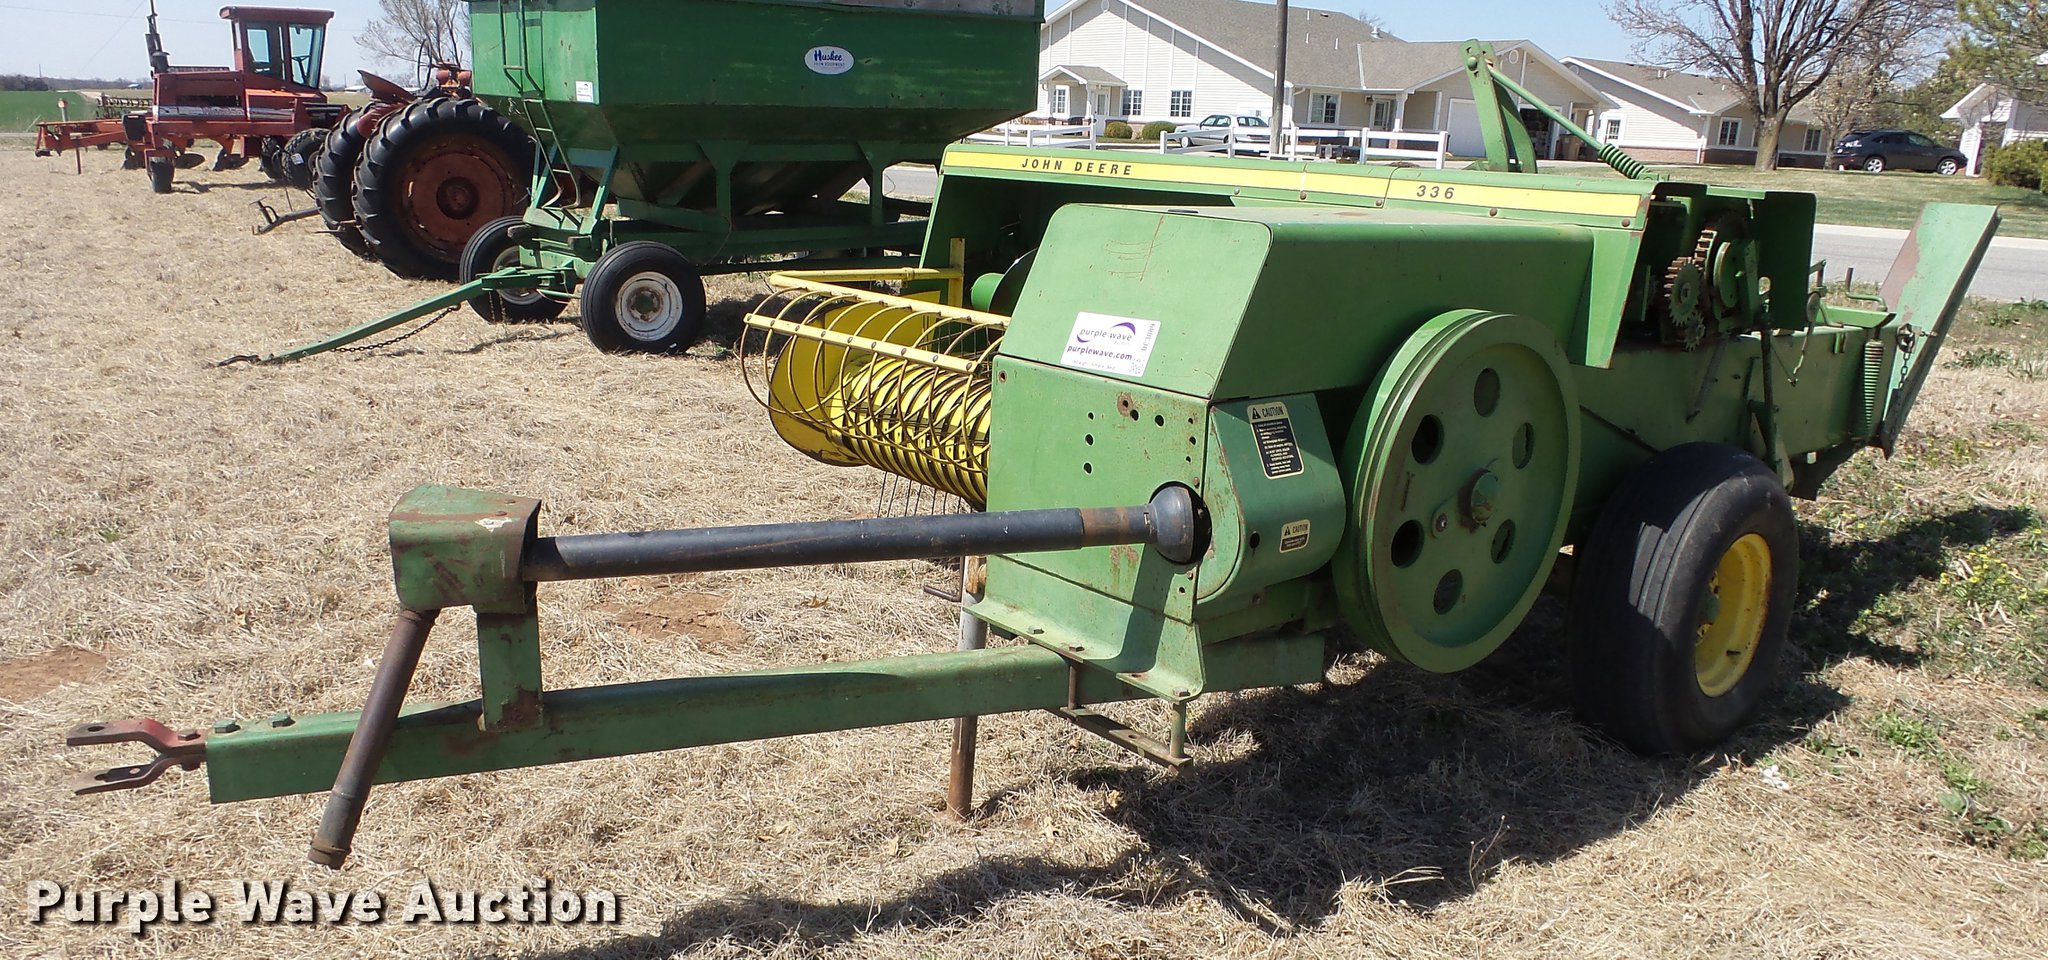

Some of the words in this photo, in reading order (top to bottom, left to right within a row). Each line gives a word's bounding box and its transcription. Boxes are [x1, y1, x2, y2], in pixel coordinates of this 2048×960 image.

[814, 49, 843, 61] Huskee
[1021, 157, 1064, 171] JOHN
[1074, 161, 1133, 177] DEERE
[1416, 184, 1456, 200] 336
[1080, 328, 1107, 338] purple
[1109, 331, 1133, 342] wave
[1067, 346, 1133, 360] purplewave.com
[1262, 406, 1284, 417] CAUTION
